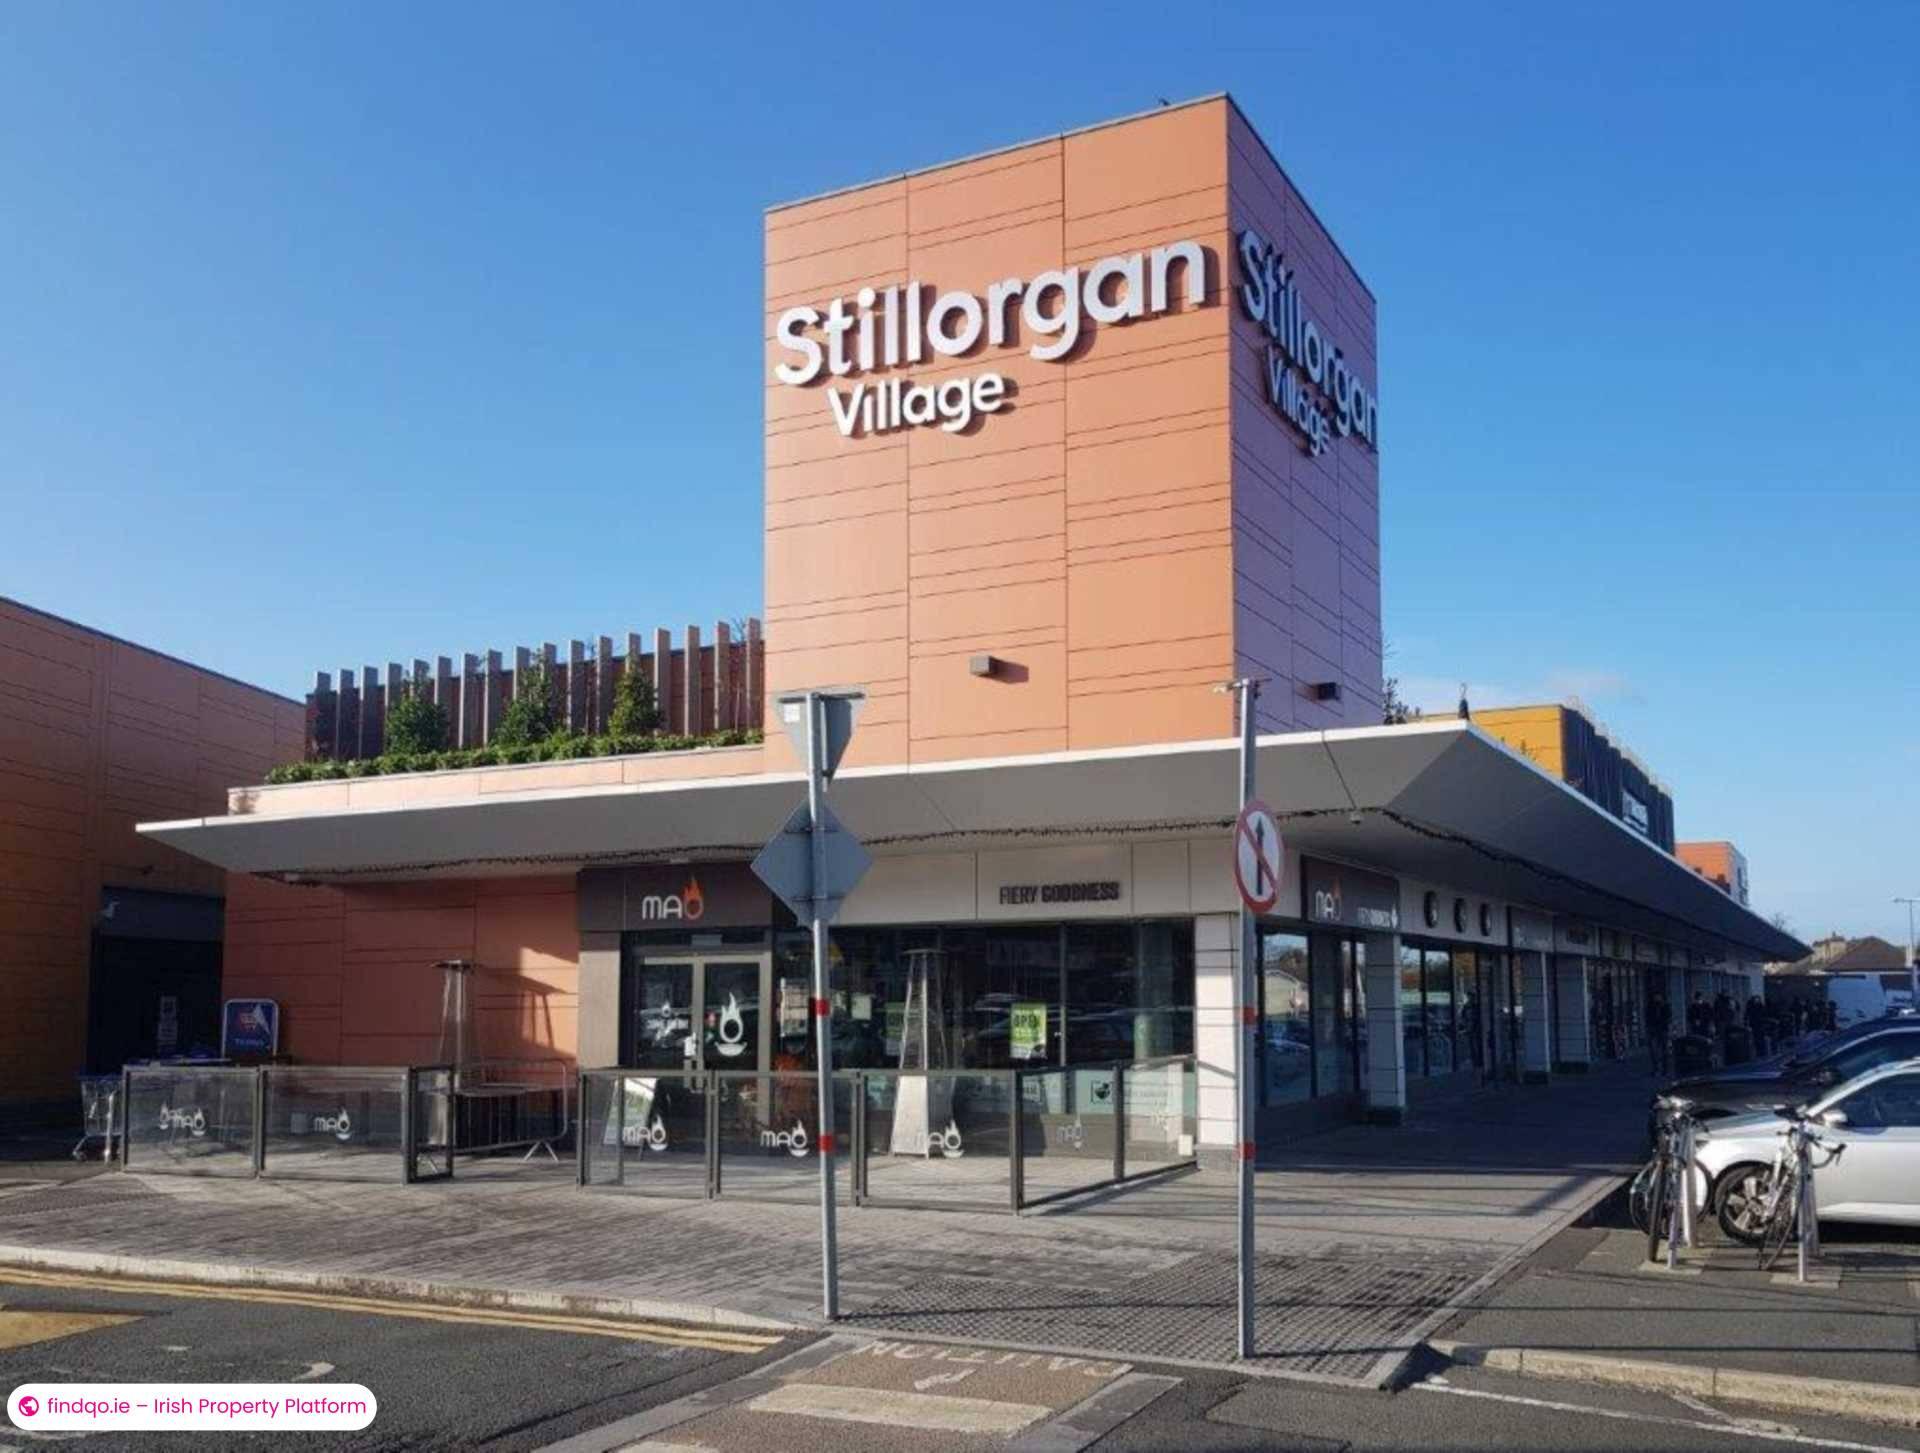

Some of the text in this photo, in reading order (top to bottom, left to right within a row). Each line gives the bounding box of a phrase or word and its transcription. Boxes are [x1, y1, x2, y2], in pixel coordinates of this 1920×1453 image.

[775, 240, 1205, 387] Stillorgan
[1240, 230, 1378, 445] Stillorgan
[828, 371, 1005, 437] Village
[1267, 346, 1331, 457] Village
[999, 882, 1120, 904] FIERY GOODNESS
